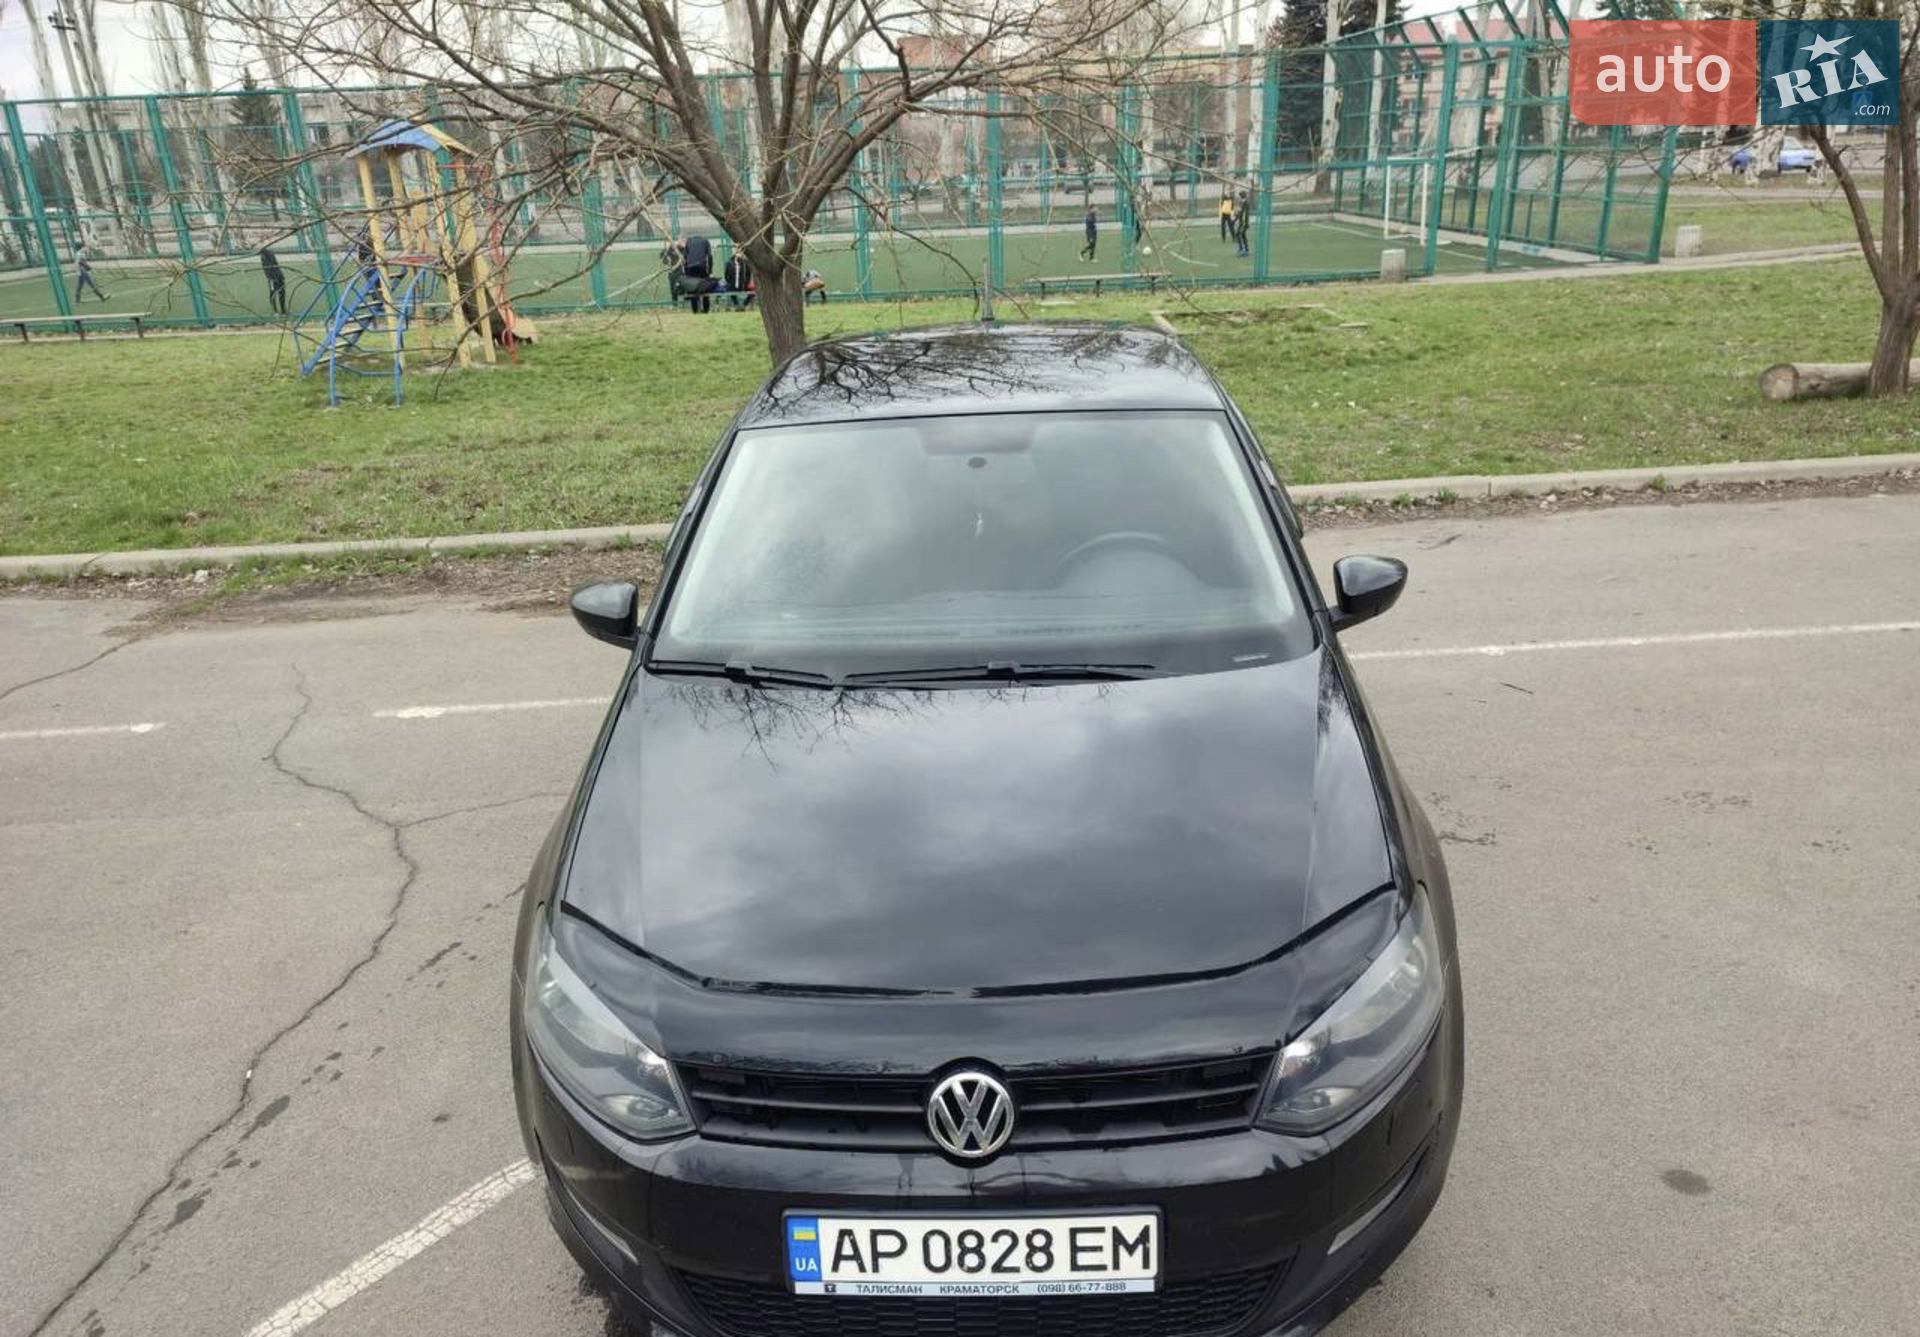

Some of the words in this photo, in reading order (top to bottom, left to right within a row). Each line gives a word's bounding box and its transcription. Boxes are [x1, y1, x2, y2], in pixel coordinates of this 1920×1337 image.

[831, 1228, 908, 1273] AP
[922, 1228, 1055, 1273] 0828
[1069, 1225, 1151, 1272] EM
[795, 1257, 818, 1272] UA
[856, 1284, 923, 1294] ТАЛИСМАН
[939, 1284, 1020, 1294] КРАМАТОРСК
